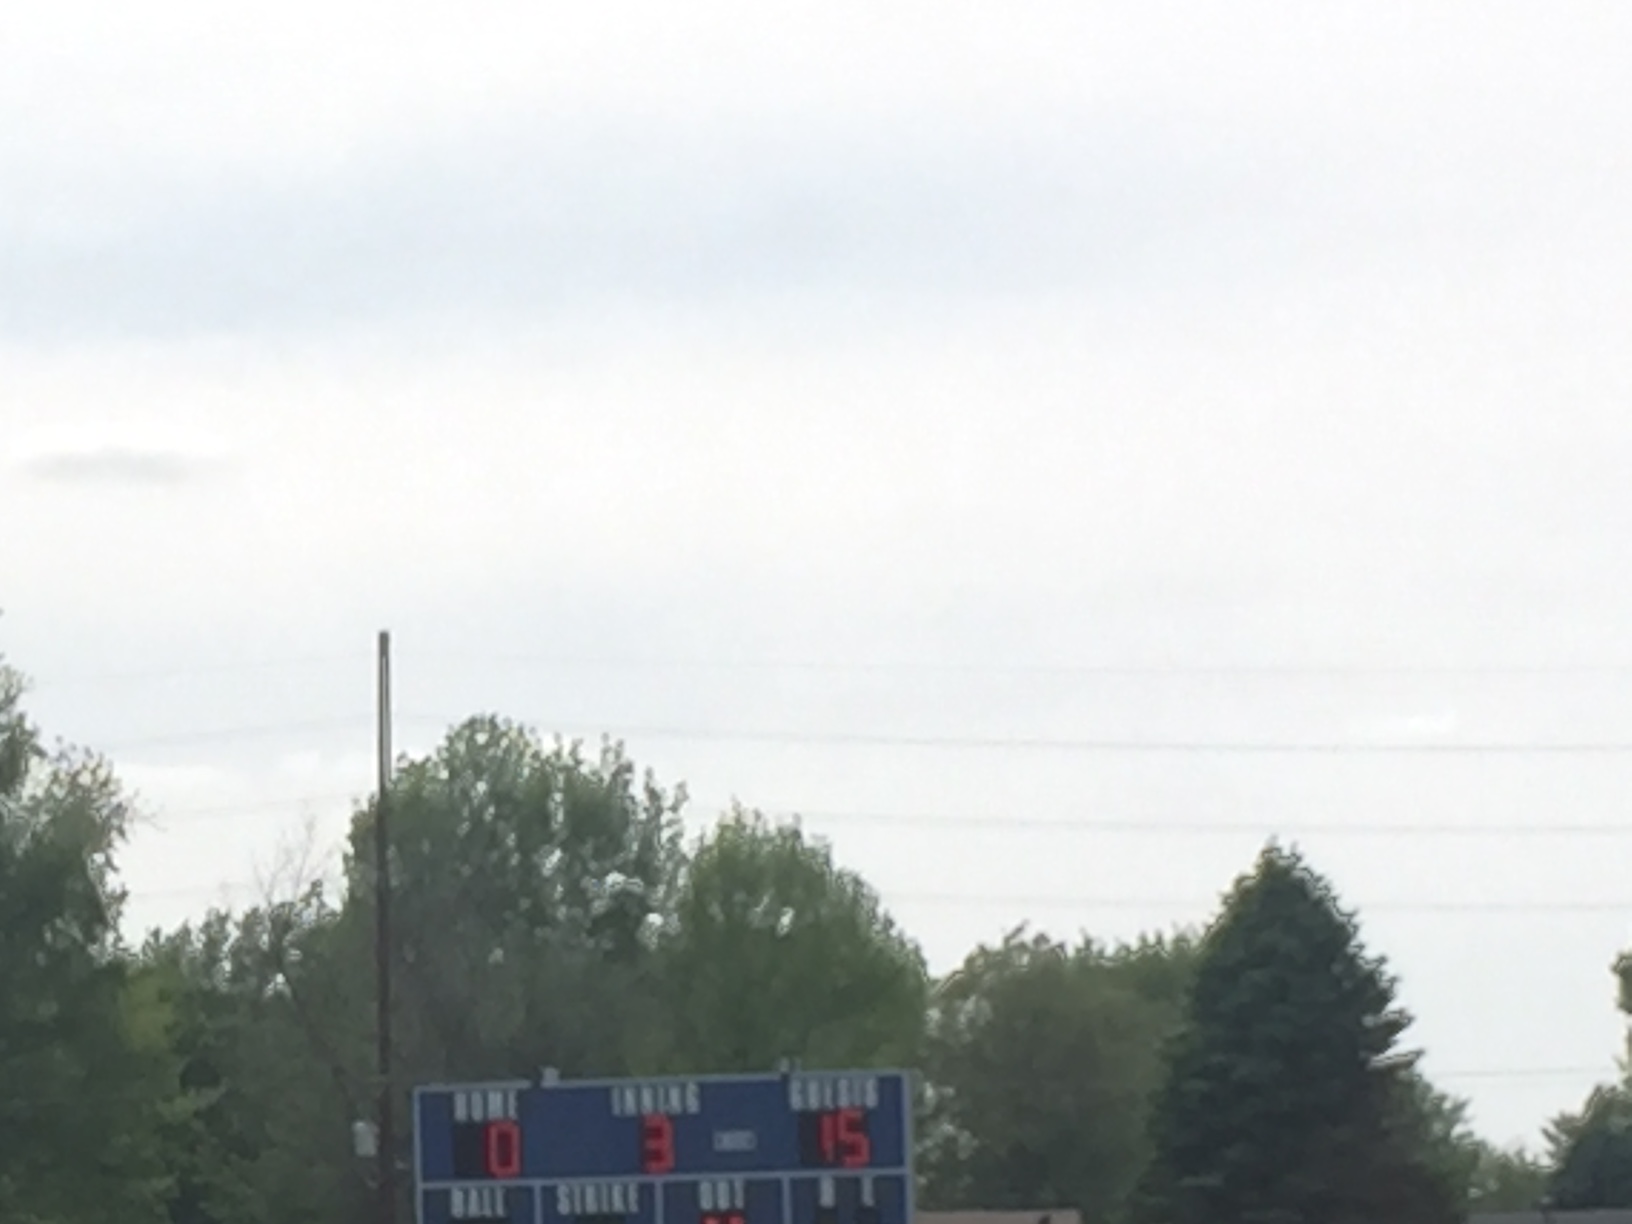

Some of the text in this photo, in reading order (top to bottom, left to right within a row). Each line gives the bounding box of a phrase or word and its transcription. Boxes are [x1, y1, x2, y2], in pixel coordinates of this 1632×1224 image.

[486, 1120, 522, 1178] 0
[641, 1113, 676, 1175] 3
[819, 1107, 871, 1168] 15
